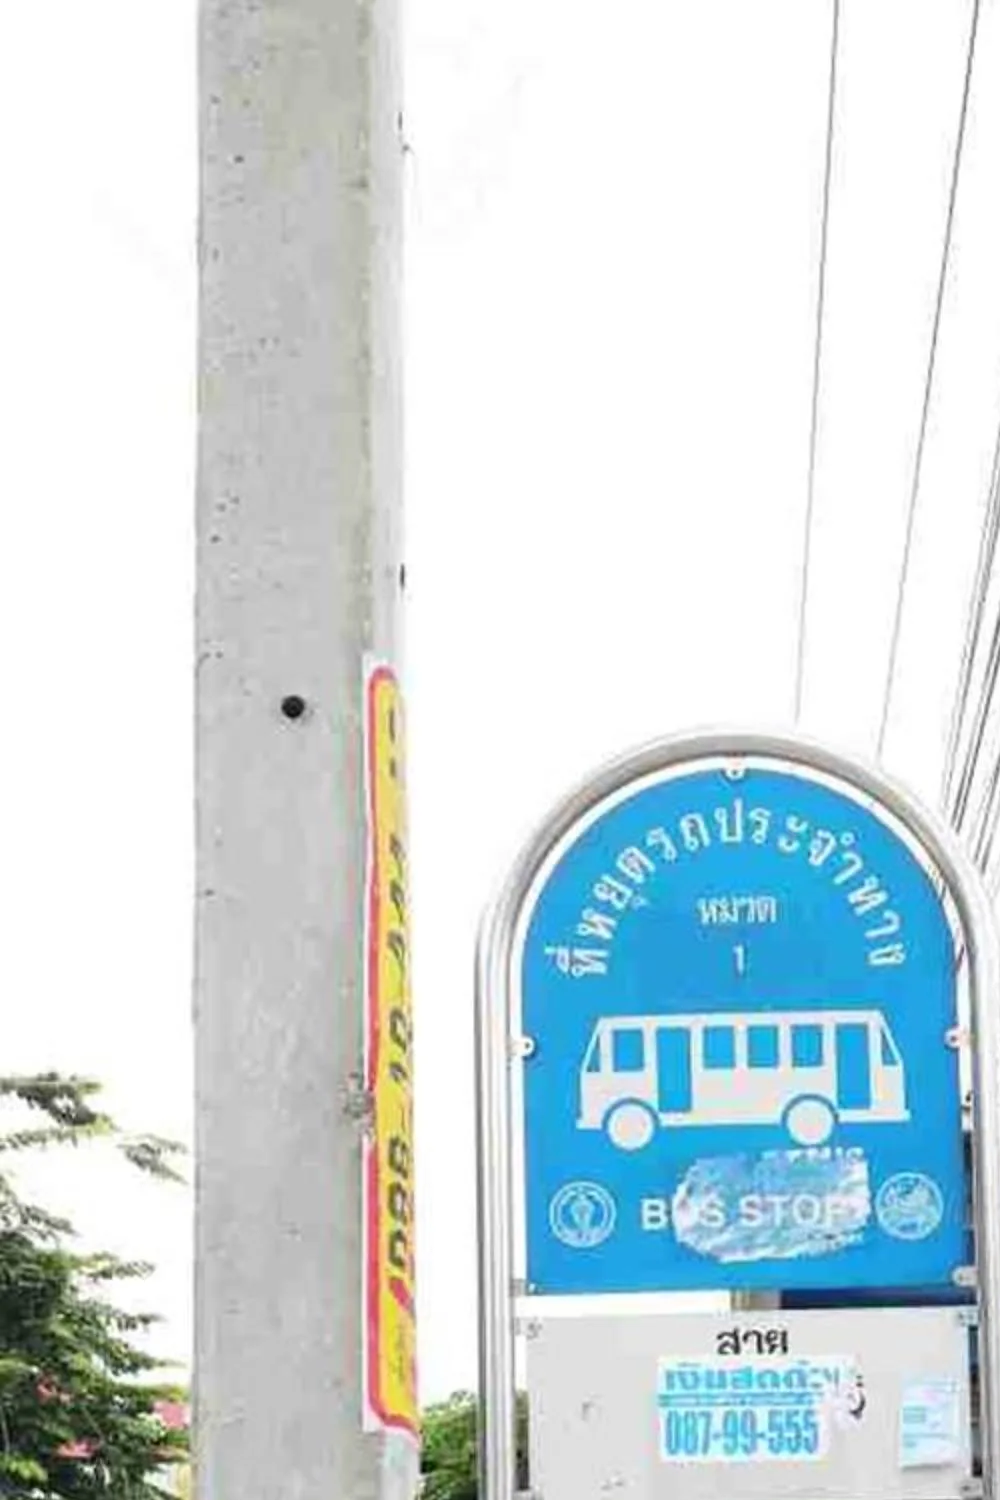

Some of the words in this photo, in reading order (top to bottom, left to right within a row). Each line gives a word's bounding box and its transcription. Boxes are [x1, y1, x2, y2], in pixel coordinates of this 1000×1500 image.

[544, 797, 905, 977] ที่หยุดรถประจำทาง
[697, 895, 778, 925] หมวด
[716, 1327, 790, 1356] สาย
[665, 1408, 819, 1456] 087-99-555
